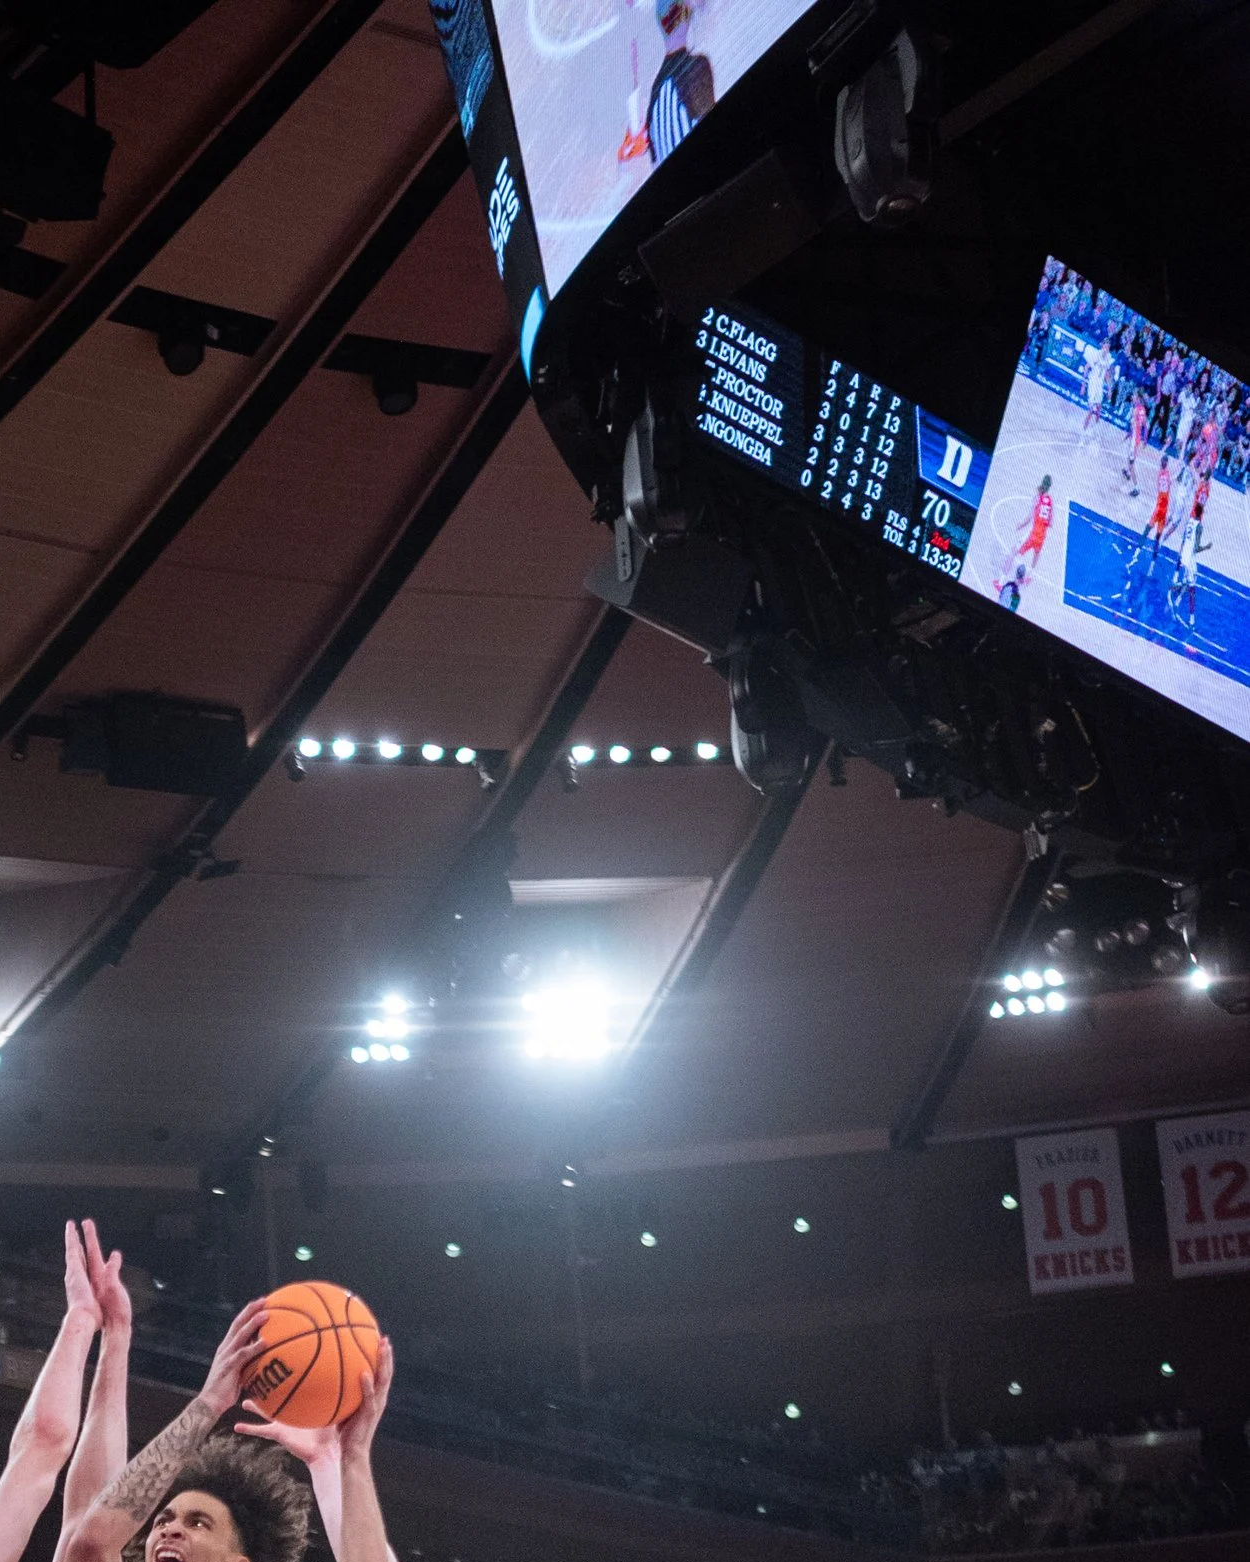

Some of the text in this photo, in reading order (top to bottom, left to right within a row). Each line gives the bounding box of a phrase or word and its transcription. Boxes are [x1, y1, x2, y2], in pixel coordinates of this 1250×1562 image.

[696, 330, 894, 457] 3 I.EVANS 3 0 1 12
[702, 307, 900, 434] 2 C.FLAGG 2 4 7 13
[830, 360, 900, 411] F A R P
[705, 360, 888, 479] .PROCTOR 3 3 3 12
[696, 413, 872, 520] .NGONGBA 0 2 4 3
[806, 447, 818, 465] 2
[827, 458, 838, 476] 2
[847, 470, 858, 487] 3
[865, 479, 882, 500] 13
[886, 509, 921, 539] FLS 4
[922, 489, 950, 527] 70
[883, 524, 916, 553] TOL 3
[922, 543, 961, 577] 13:32
[1039, 1175, 1108, 1241] 10
[1181, 1160, 1250, 1224] 12
[1033, 1246, 1125, 1280] KNICKS
